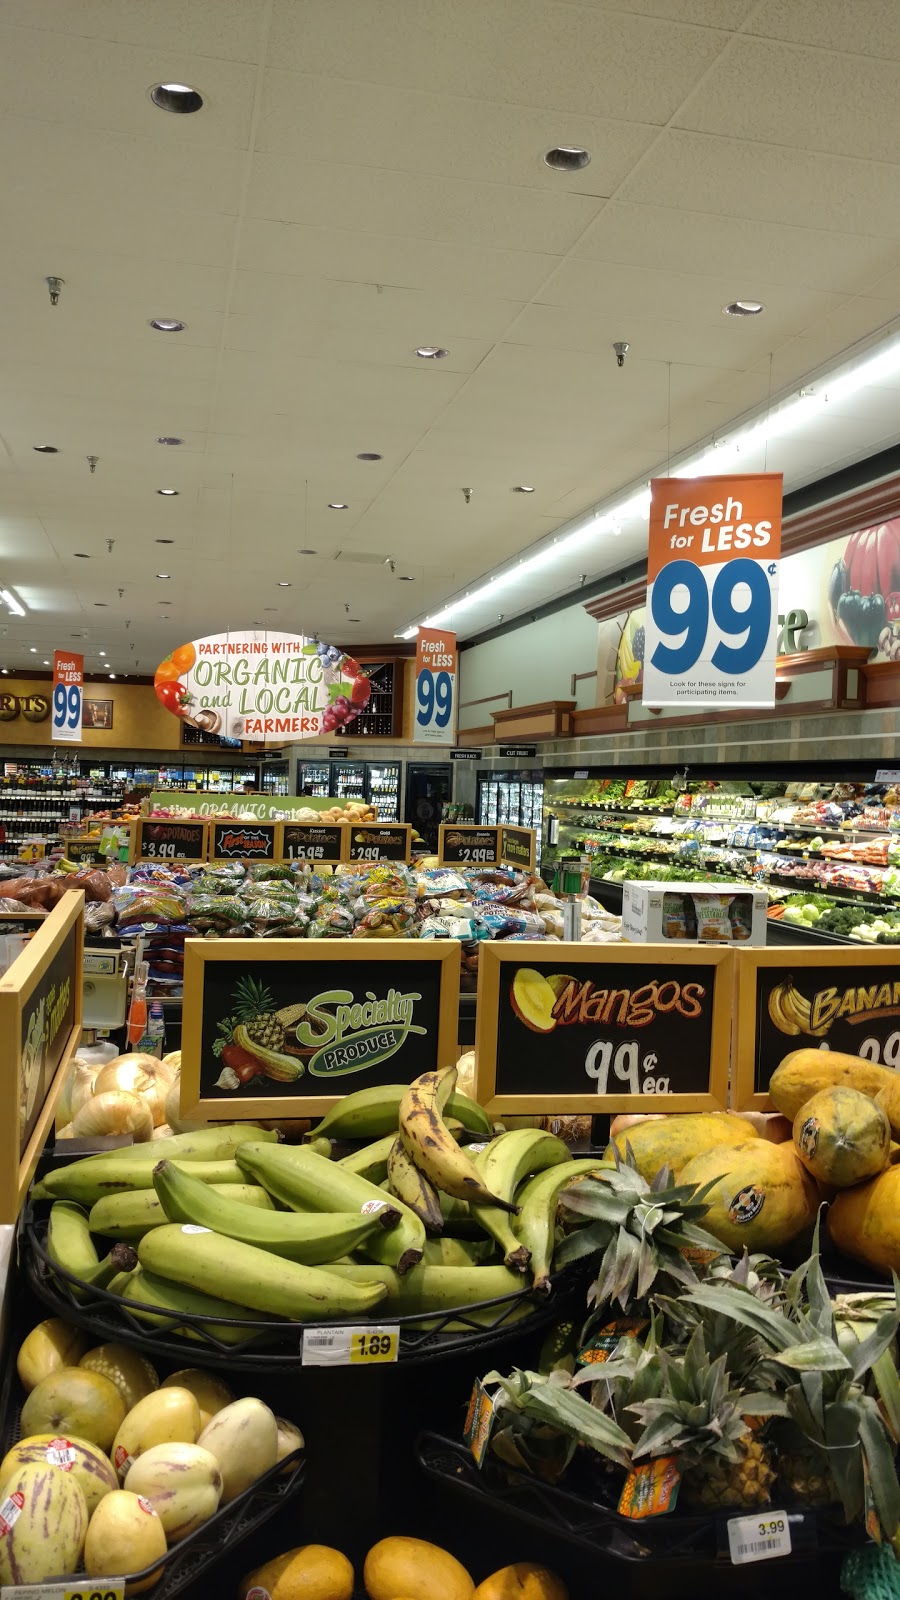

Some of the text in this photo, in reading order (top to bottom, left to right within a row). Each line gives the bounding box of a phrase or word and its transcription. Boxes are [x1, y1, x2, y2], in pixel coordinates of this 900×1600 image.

[664, 497, 743, 529] Fresh
[670, 521, 772, 553] for LESS
[199, 642, 300, 655] PARTNERING WITH
[421, 640, 445, 653] Fresh
[57, 661, 76, 670] Fresh
[432, 655, 453, 667] LESS
[65, 672, 81, 681] LESS
[193, 657, 324, 686] ORGANIC
[200, 686, 326, 715] and LOCAL
[245, 717, 320, 734] FARMERS
[167, 827, 200, 841] POTATOES
[223, 834, 244, 849] First
[243, 840, 266, 849] SEASON
[458, 849, 486, 862] $2.99
[553, 980, 706, 1028] Mangos
[296, 988, 424, 1047] Specialty
[323, 1031, 396, 1071] PRODUCE
[358, 1335, 391, 1355] 1.89
[758, 1520, 785, 1536] 3.99
